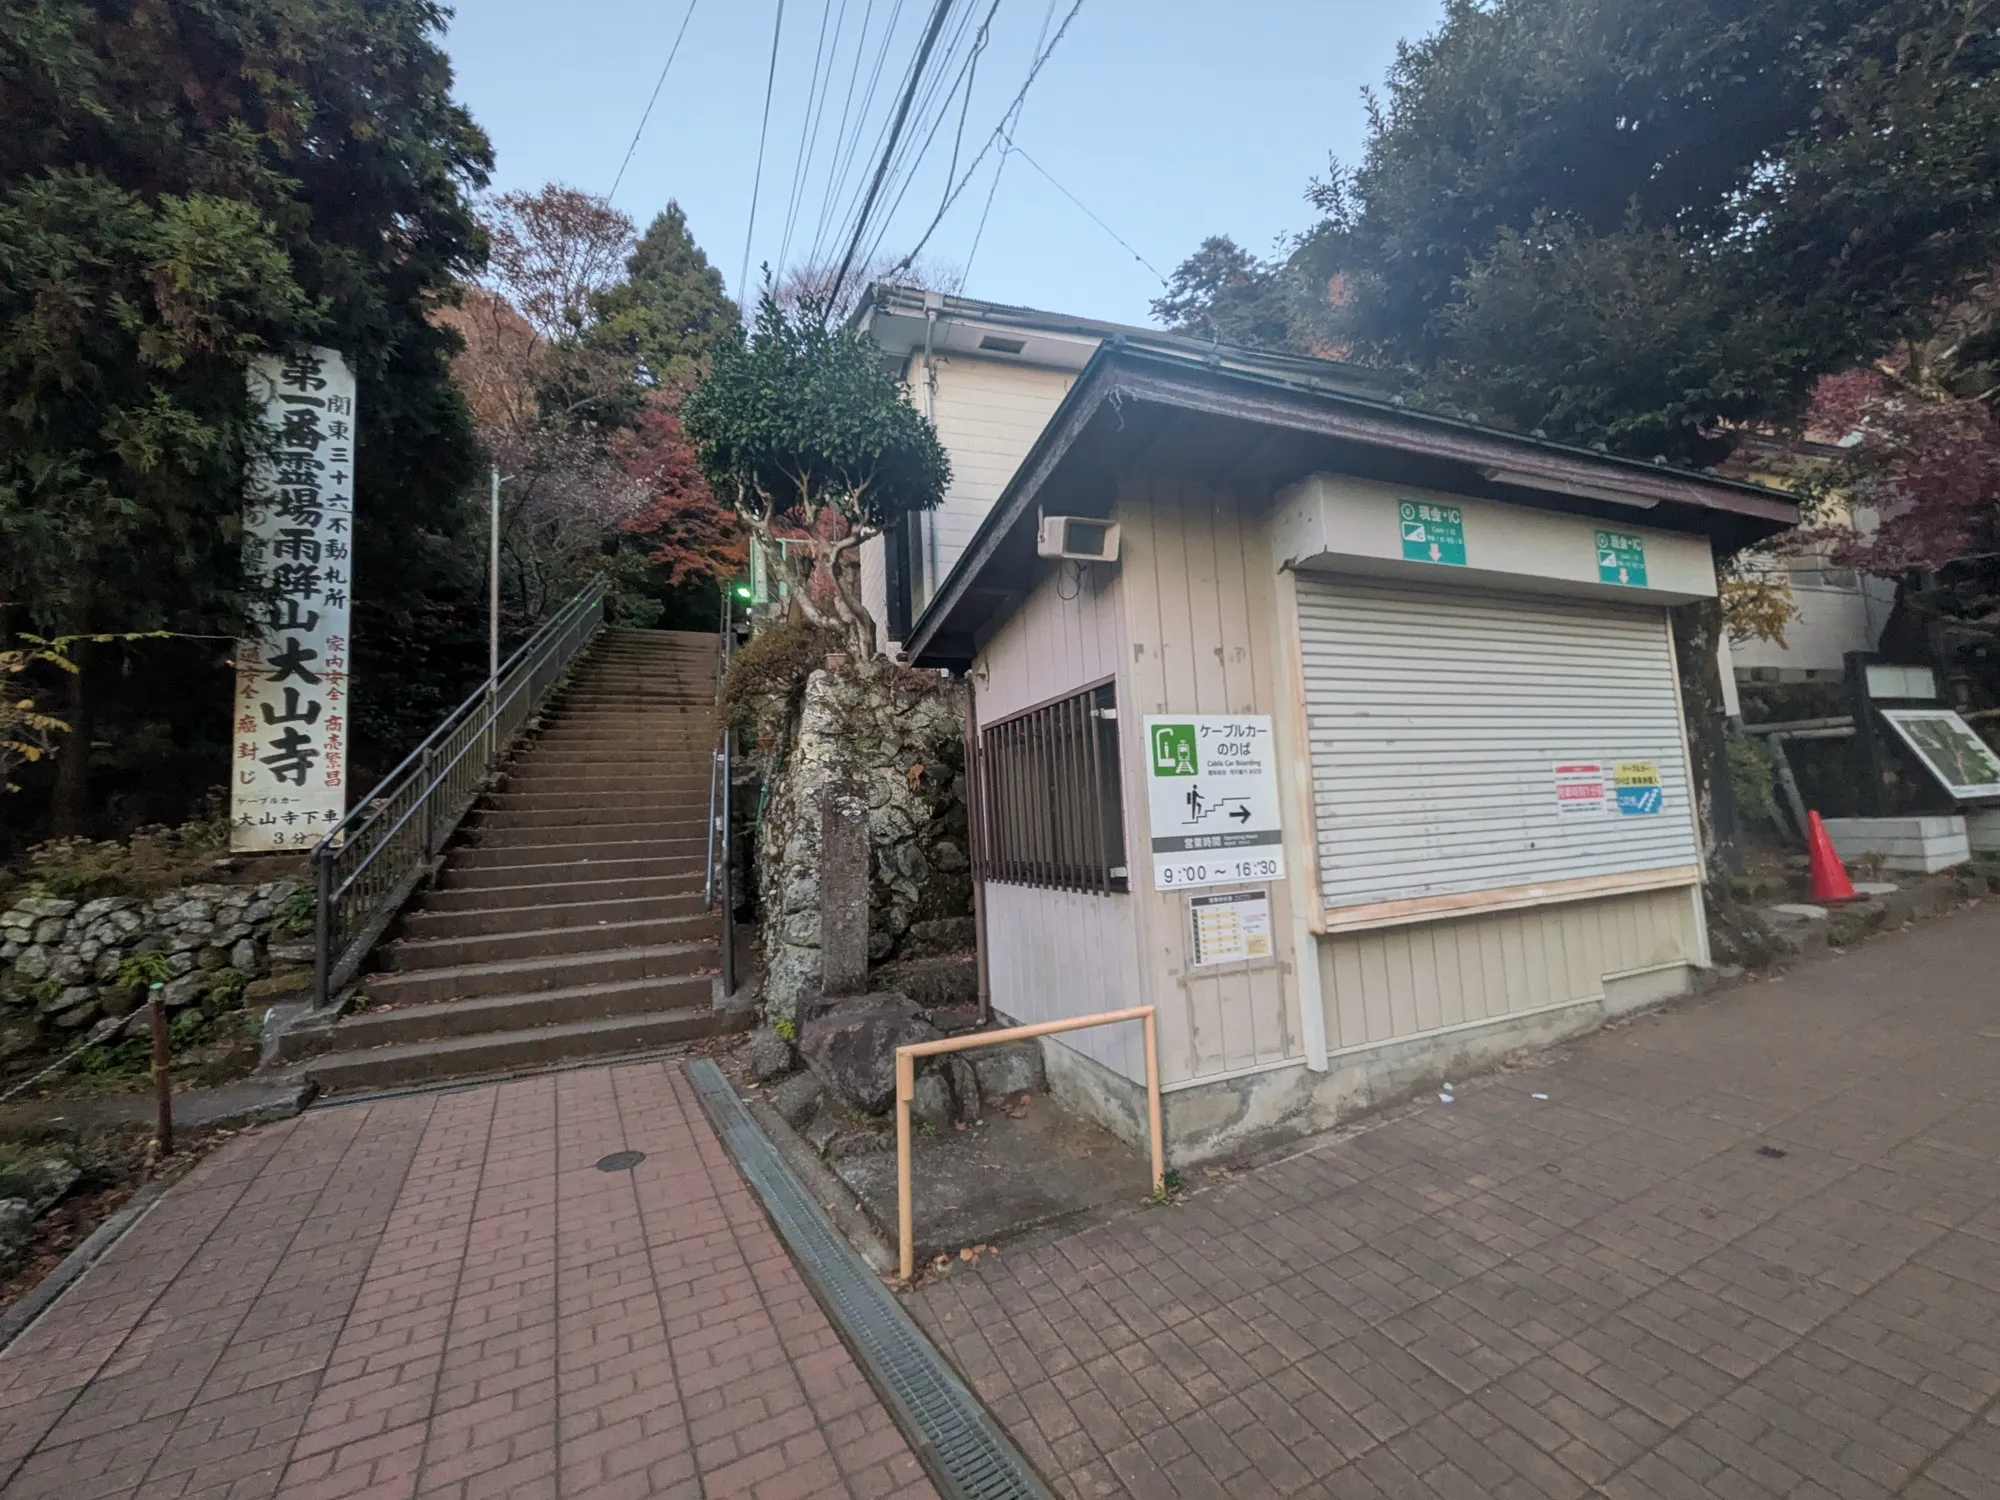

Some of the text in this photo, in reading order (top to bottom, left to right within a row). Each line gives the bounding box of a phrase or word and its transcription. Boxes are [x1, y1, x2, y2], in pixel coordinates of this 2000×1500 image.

[323, 394, 352, 609] 関東三十六不動札所
[1200, 724, 1267, 738] ケーブルカー
[1217, 742, 1251, 756] のりば
[237, 797, 300, 806] ケーブルカー
[238, 809, 340, 826] 大山寺下車
[1184, 836, 1222, 849] 営業時間
[1164, 865, 1206, 883] 9:00
[1235, 860, 1277, 877] 16:30
